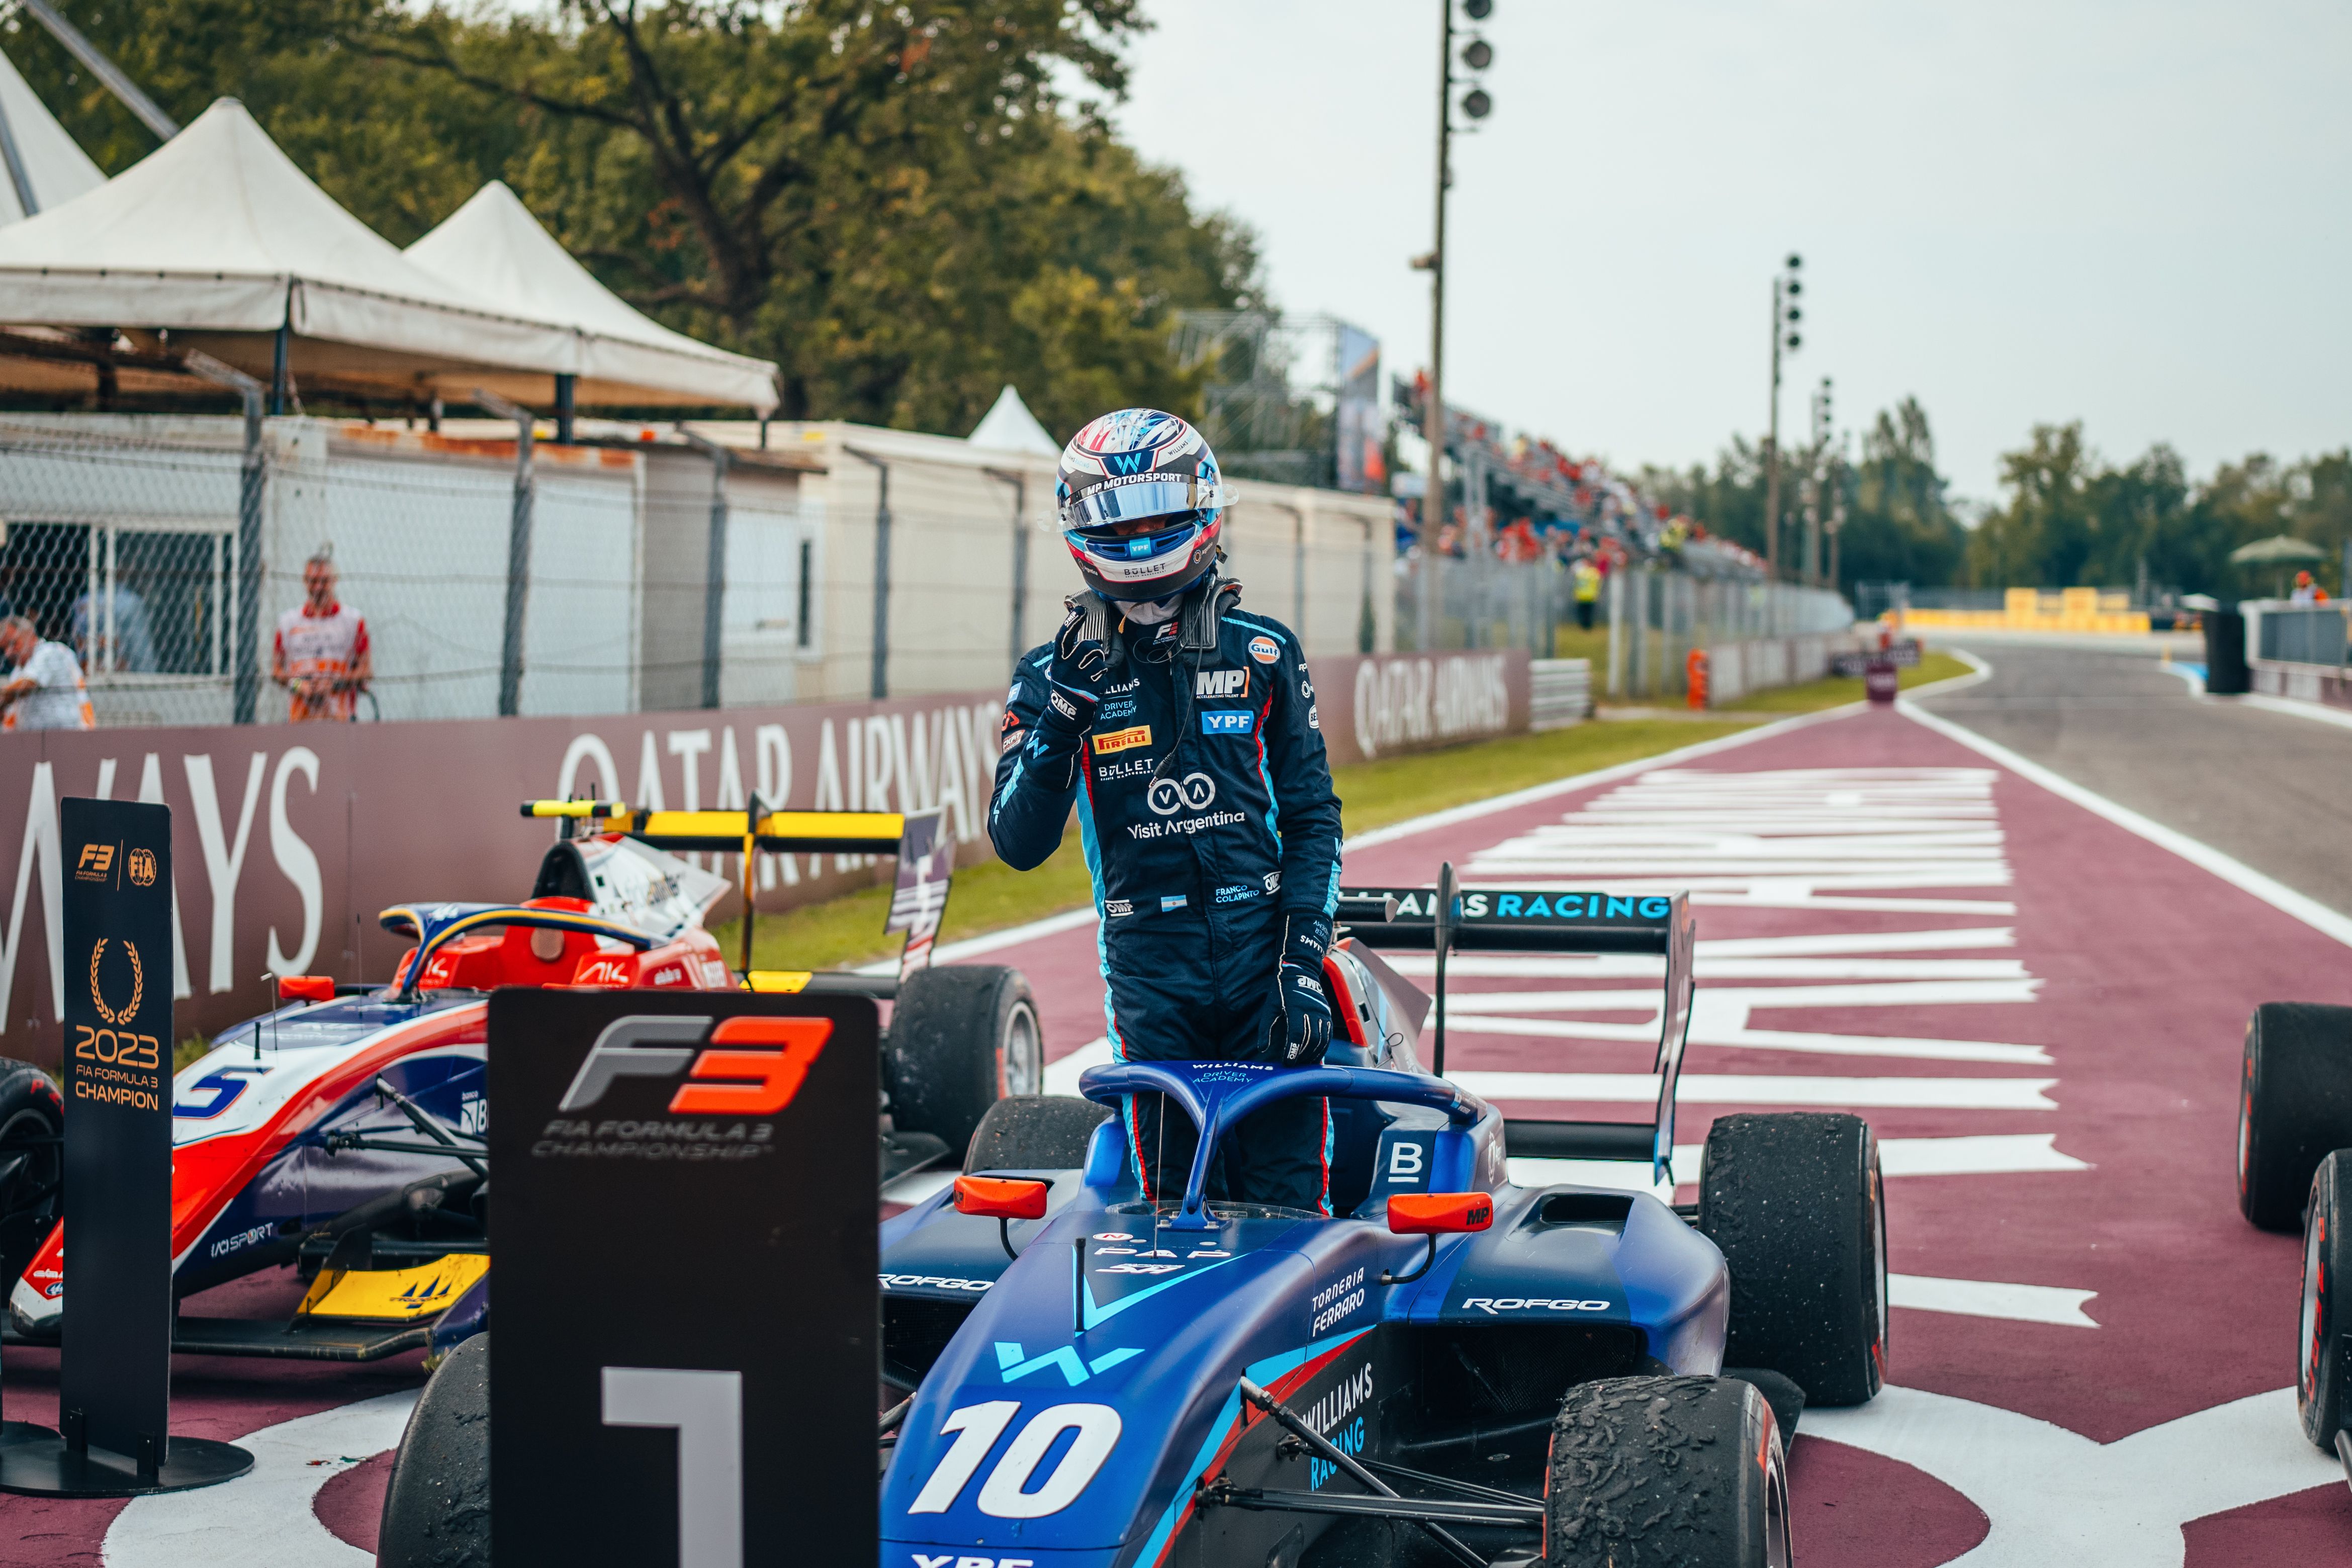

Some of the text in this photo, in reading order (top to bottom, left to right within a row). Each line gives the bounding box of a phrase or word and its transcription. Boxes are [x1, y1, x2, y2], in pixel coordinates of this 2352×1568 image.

[1087, 473, 1182, 496] MP MOTORSPORT
[1064, 611, 1077, 627] OMP
[1251, 644, 1278, 657] Gulf
[1105, 678, 1140, 695] LLIAMS
[1051, 692, 1076, 716] OMP
[1100, 705, 1137, 720] ACADEMY
[1104, 700, 1133, 711] DRIVER
[1207, 715, 1250, 728] YPF
[1098, 729, 1146, 750] PIRELLI
[1127, 810, 1246, 840] Visit Argentina
[78, 844, 115, 871] F3
[1216, 885, 1248, 896] FRANCO
[1265, 873, 1280, 891] OMP
[1216, 889, 1259, 903] COLAPINTO
[1496, 894, 1670, 919] RACING
[1106, 902, 1134, 914] OMP
[76, 1025, 159, 1070] 2023
[1289, 1043, 1297, 1059] OMP
[559, 1014, 835, 1115] F3
[1193, 1062, 1274, 1070] WILLIAMS
[76, 1064, 158, 1089] FIA FORMULA 3
[76, 1081, 158, 1111] CHAMPION
[542, 1120, 775, 1142] FIA FORMULA 3
[531, 1140, 762, 1159] CHAMPIONSHIP
[1389, 1142, 1423, 1174] B
[1466, 1207, 1489, 1226] MP
[230, 1222, 273, 1252] SPORT
[877, 1273, 995, 1291] ROFGO
[1312, 1288, 1365, 1338] FERRARO
[1462, 1298, 1610, 1315] ROFGO
[1303, 1362, 1373, 1435] WILLIAMS
[601, 1365, 744, 1568] 1
[908, 1400, 1122, 1519] 10
